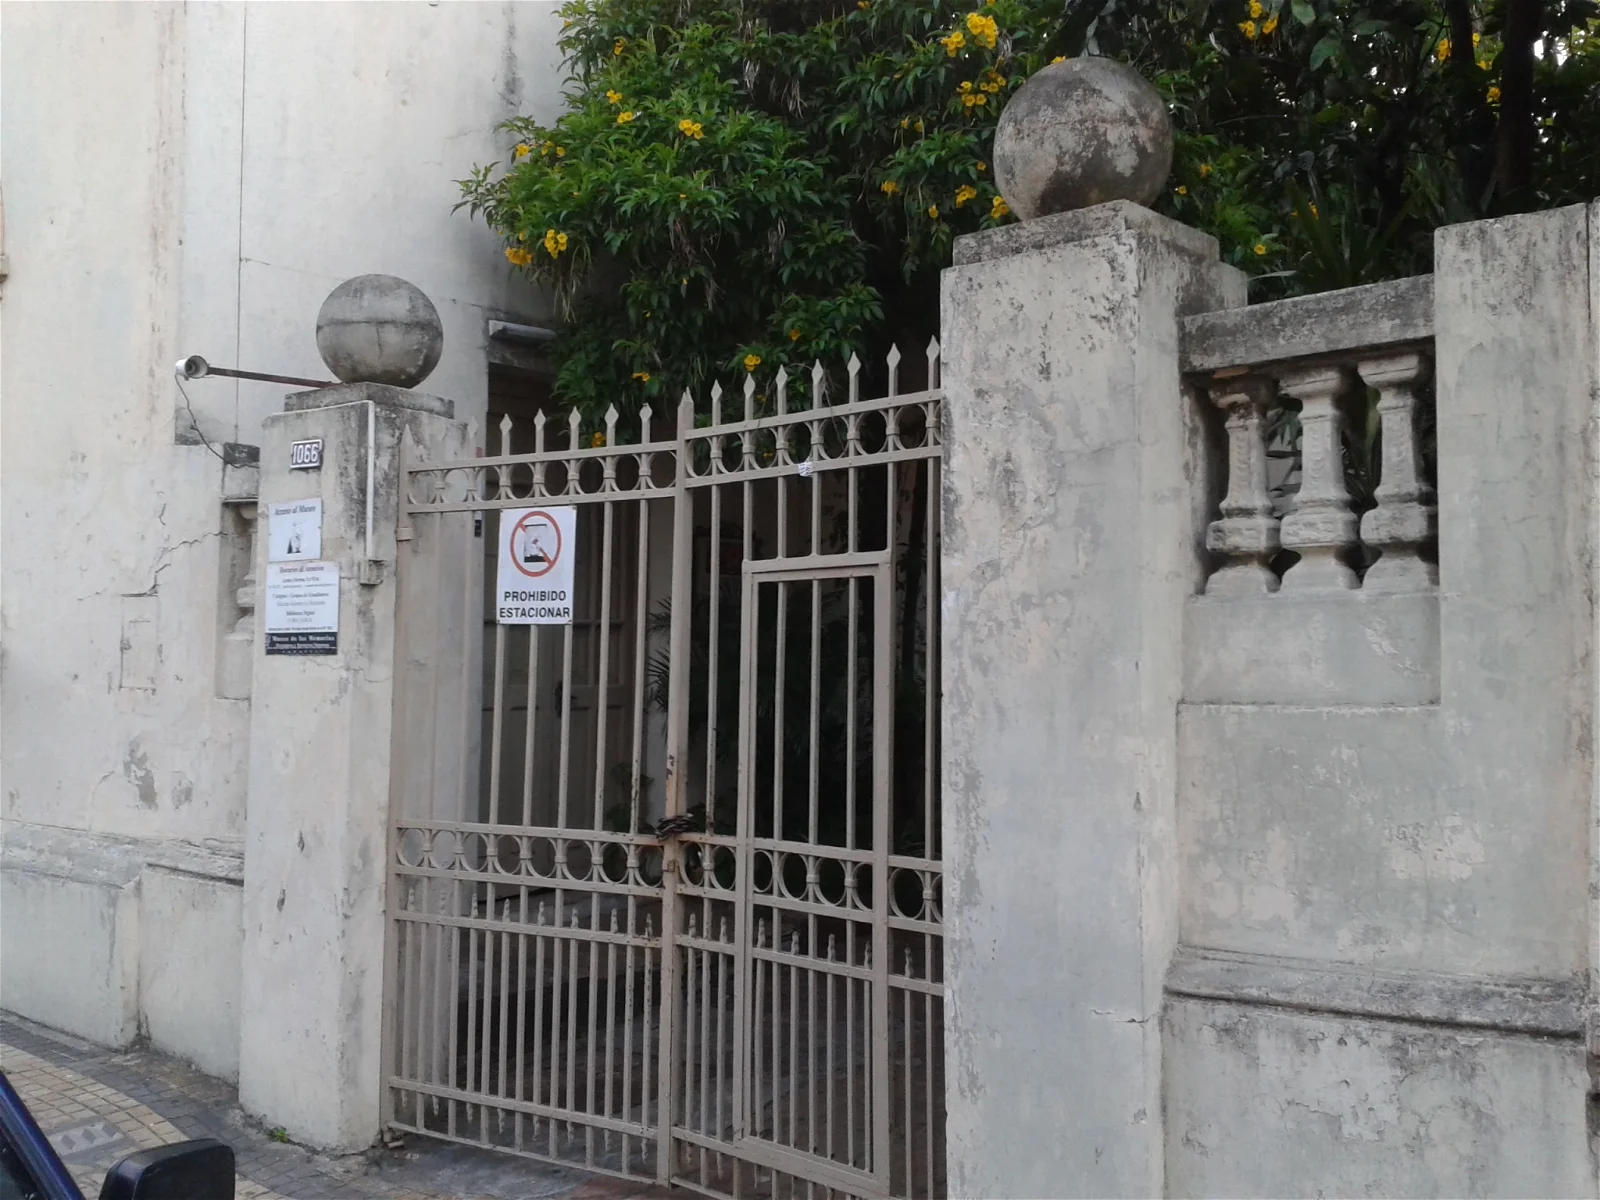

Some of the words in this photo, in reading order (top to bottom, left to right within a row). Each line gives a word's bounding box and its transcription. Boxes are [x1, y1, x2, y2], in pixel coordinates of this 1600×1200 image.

[292, 444, 318, 464] 1066
[504, 591, 566, 602] PROHIBIDO
[500, 607, 570, 618] ESTACIONAR
